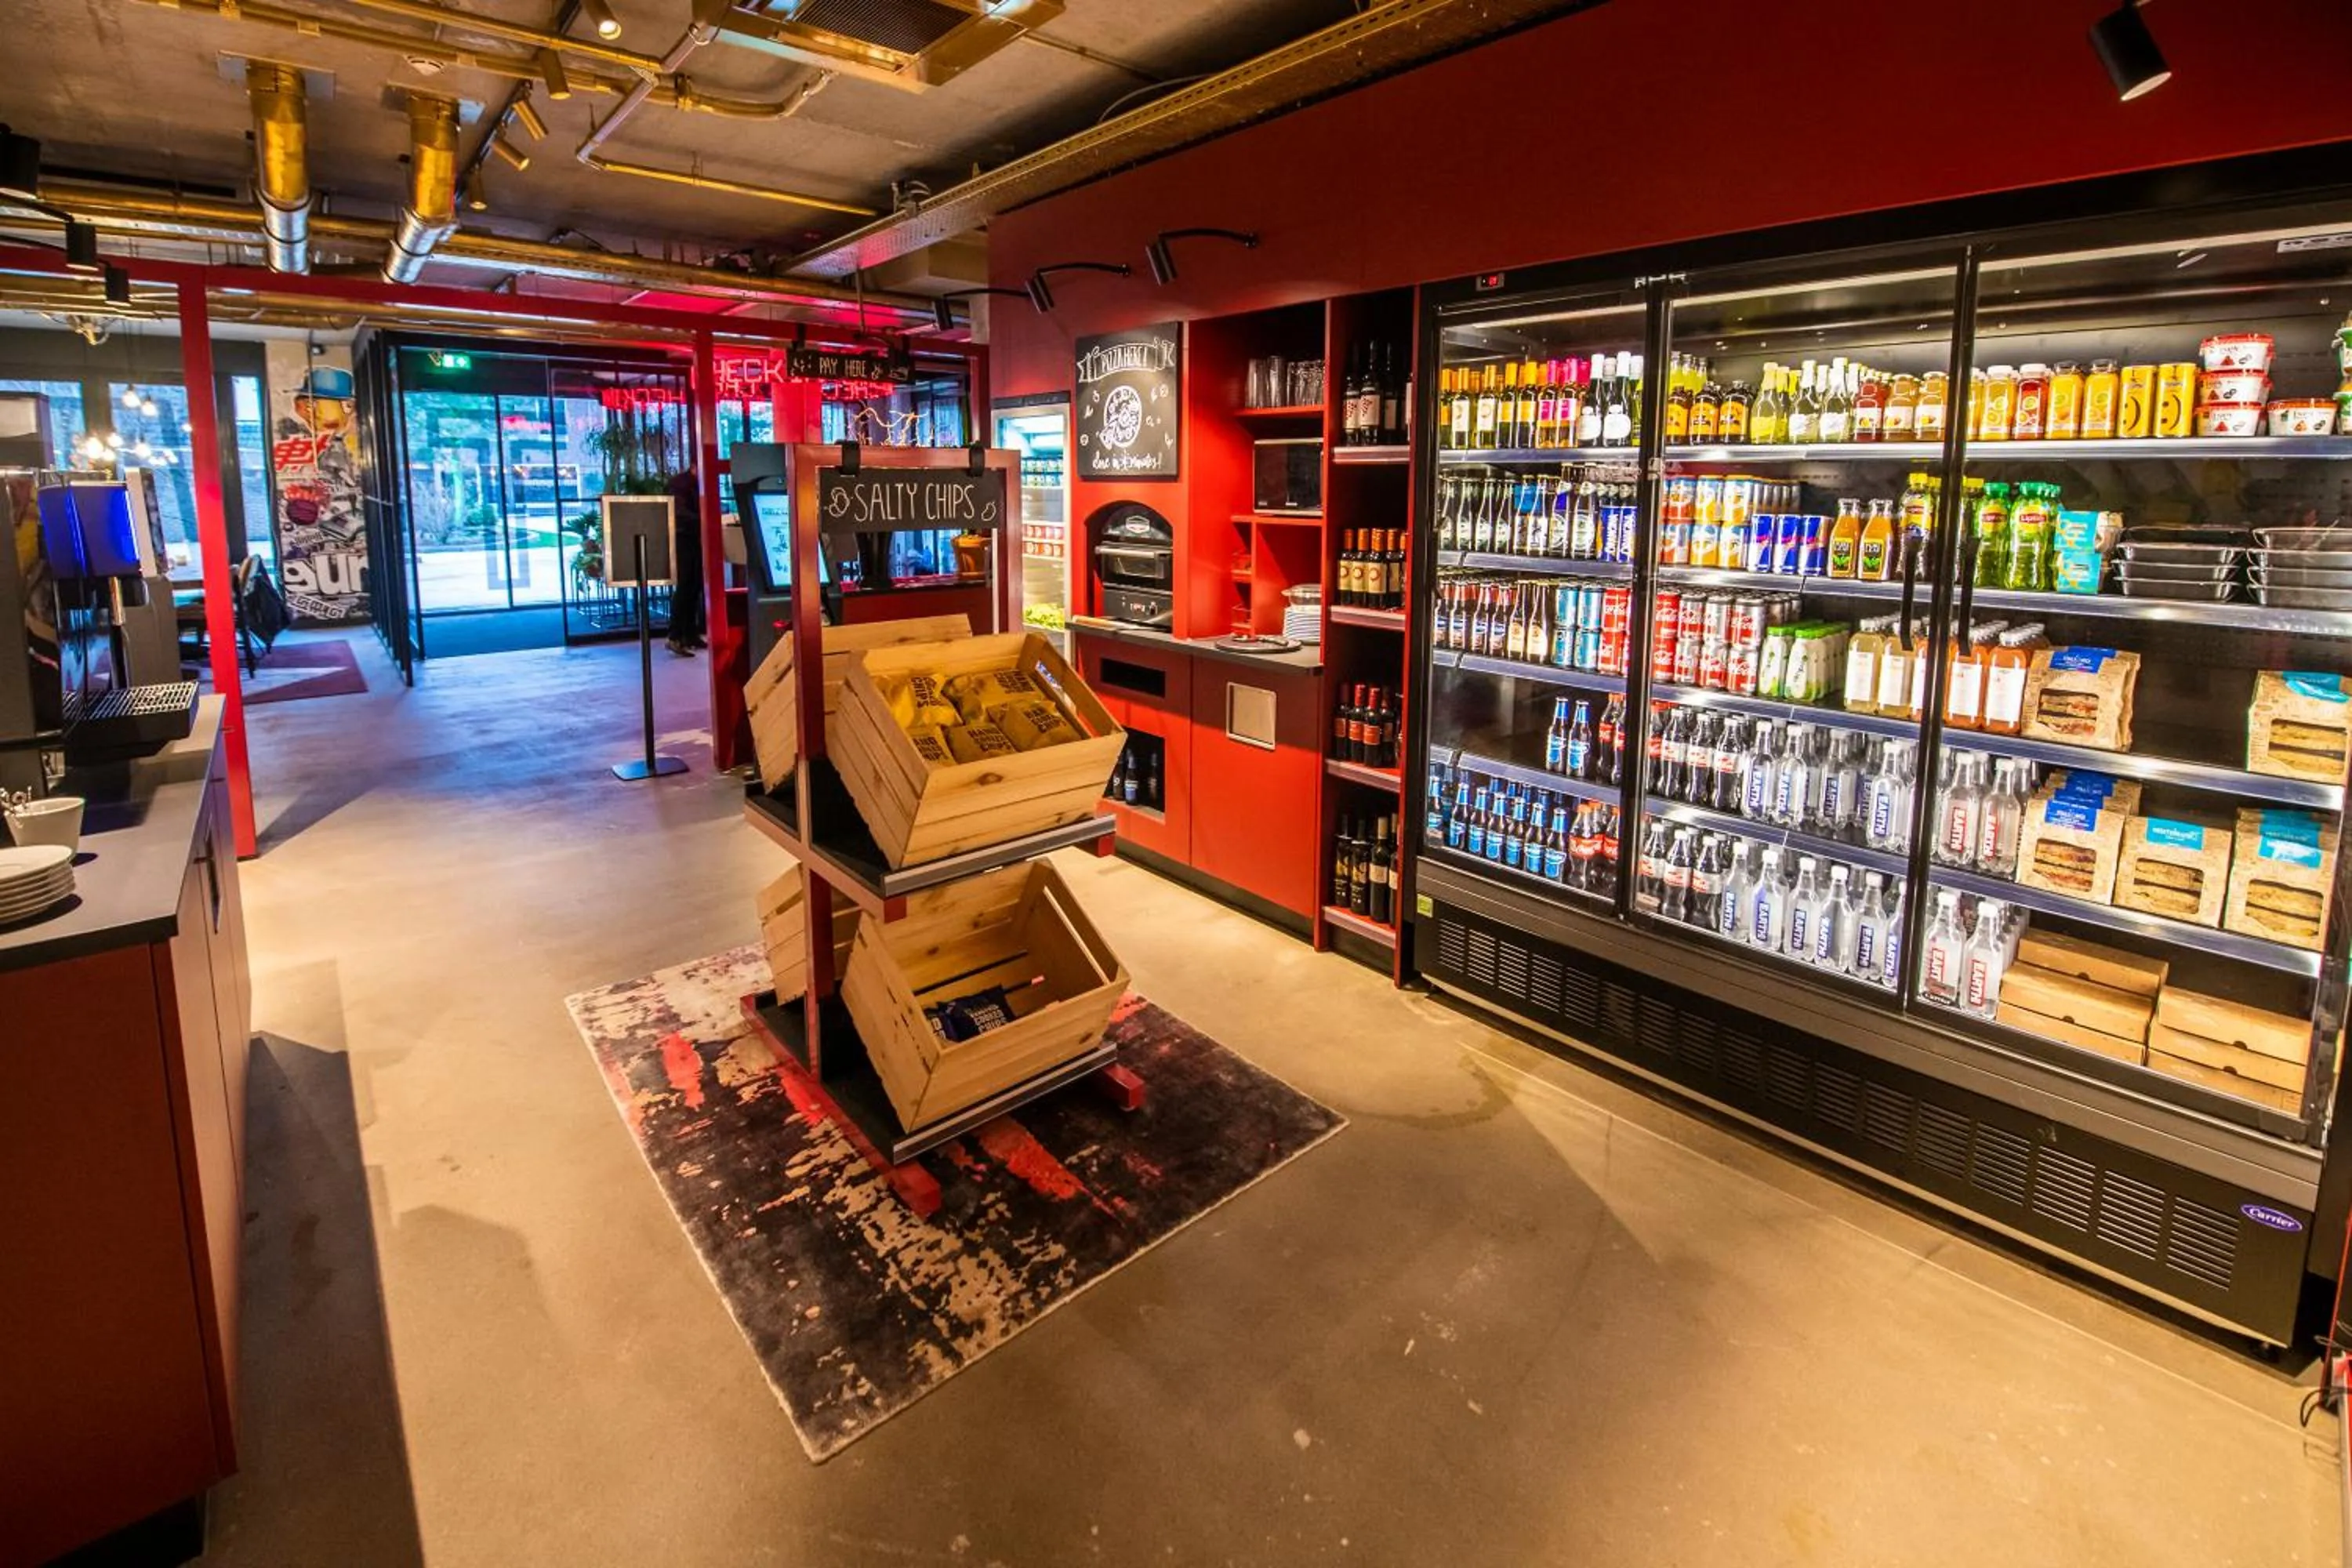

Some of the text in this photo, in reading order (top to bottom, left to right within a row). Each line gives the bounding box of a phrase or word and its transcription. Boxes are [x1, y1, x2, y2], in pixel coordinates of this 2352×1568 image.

[819, 357, 866, 377] PAY HERE
[855, 482, 975, 522] SALTY CHIPS
[1749, 770, 1762, 808] EARTH
[1875, 795, 1889, 835] EARTH
[1951, 808, 1966, 851] EARTH
[1984, 814, 1998, 857] EARTH
[1724, 892, 1735, 931] EARTH
[1757, 902, 1769, 941] EARTH
[1792, 910, 1806, 949] EARTH
[1859, 928, 1872, 967] EARTH
[1886, 935, 1897, 976] EARTH
[1930, 949, 1944, 983] EART
[1970, 962, 1985, 1004] EARTH
[2249, 1207, 2295, 1228] Carrier
